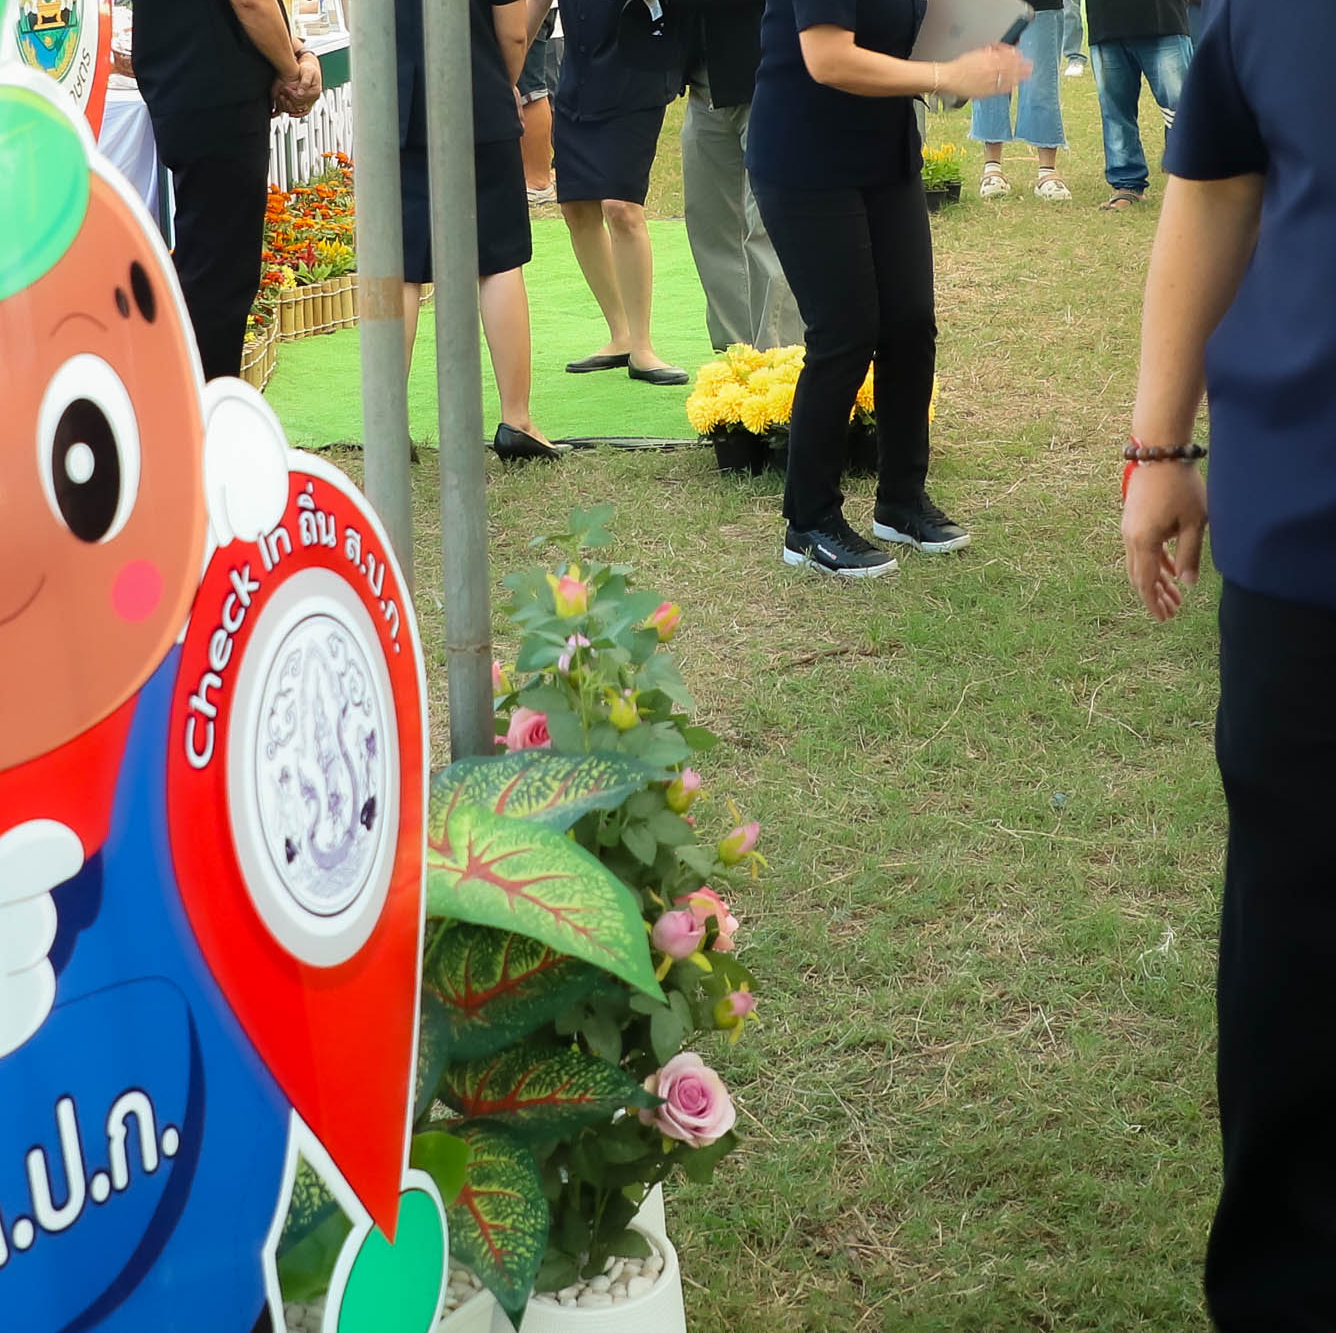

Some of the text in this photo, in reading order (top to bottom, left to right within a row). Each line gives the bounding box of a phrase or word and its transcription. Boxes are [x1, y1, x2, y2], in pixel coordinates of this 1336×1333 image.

[185, 564, 260, 769] Check
[297, 480, 337, 548] ถิ่น
[344, 527, 401, 654] ส.ป.ก.
